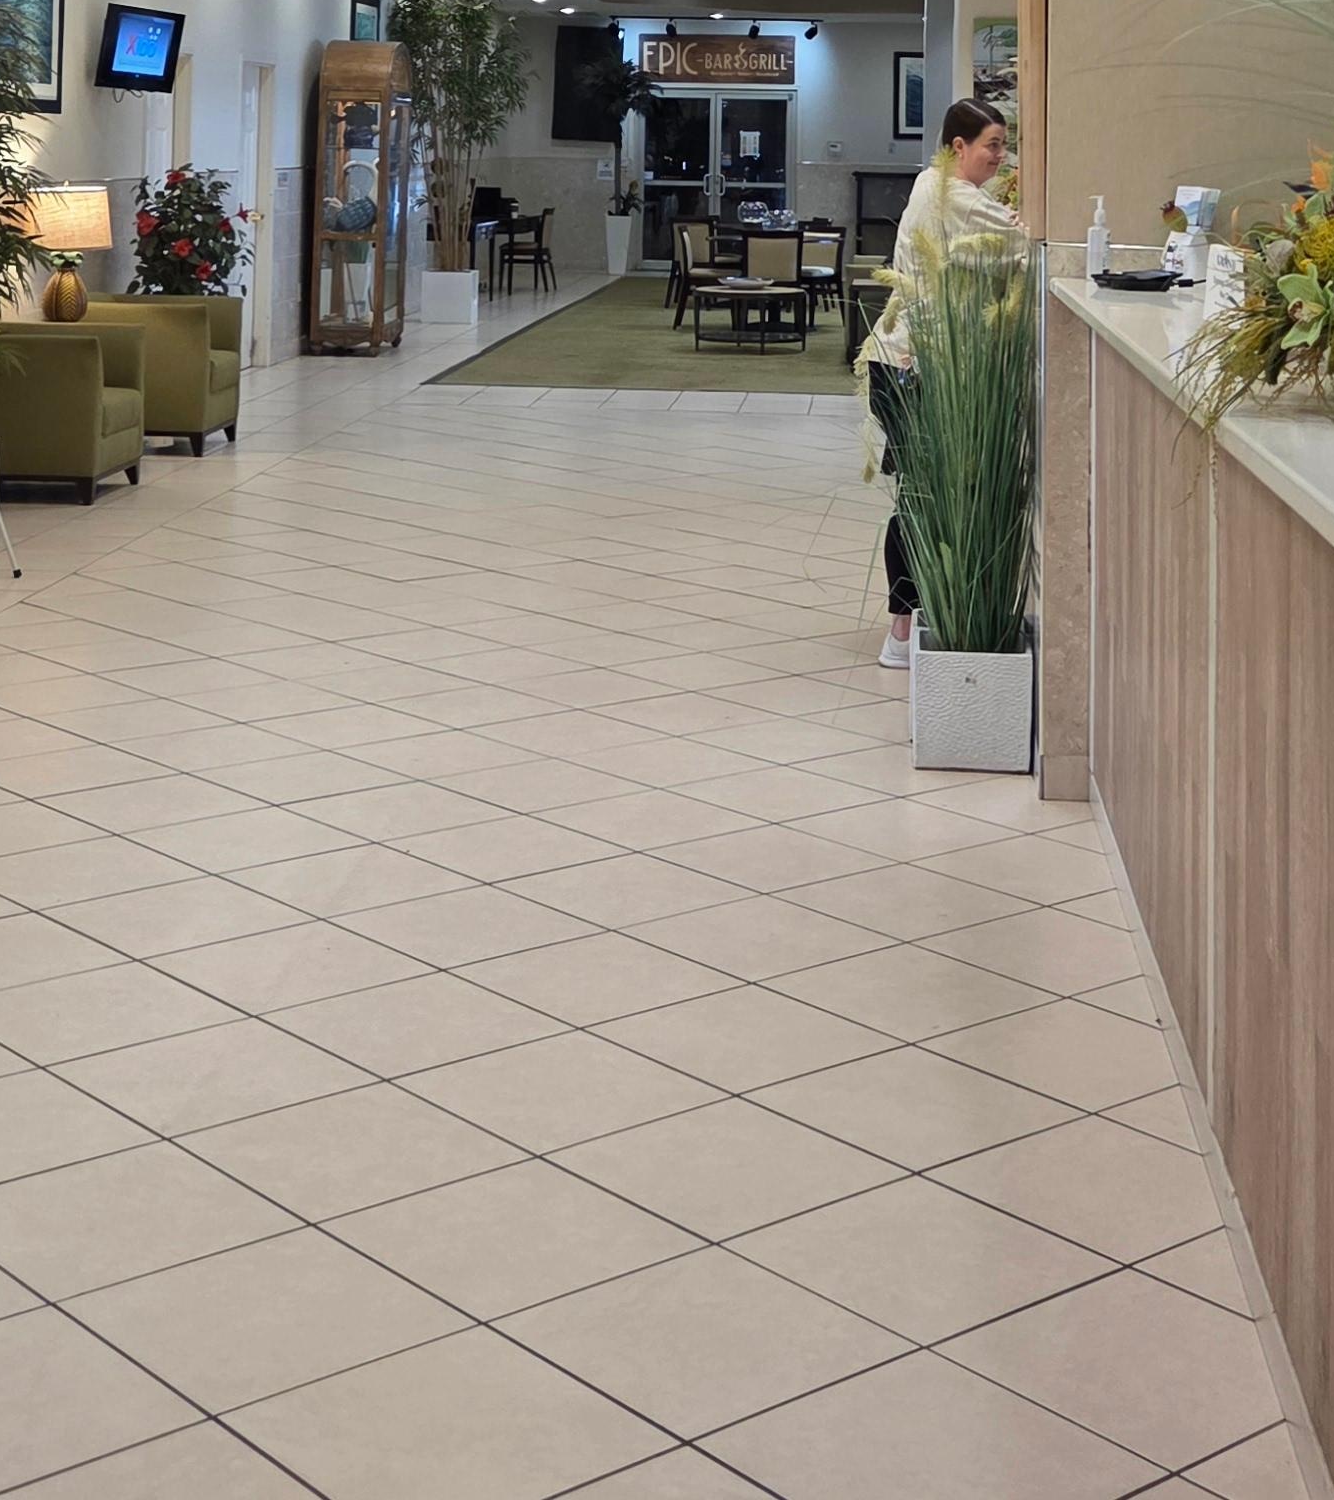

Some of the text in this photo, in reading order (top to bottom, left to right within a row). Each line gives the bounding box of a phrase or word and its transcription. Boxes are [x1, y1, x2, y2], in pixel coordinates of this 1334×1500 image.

[642, 41, 698, 75] EPIC
[704, 52, 731, 70] BAR
[748, 53, 787, 71] GRILL
